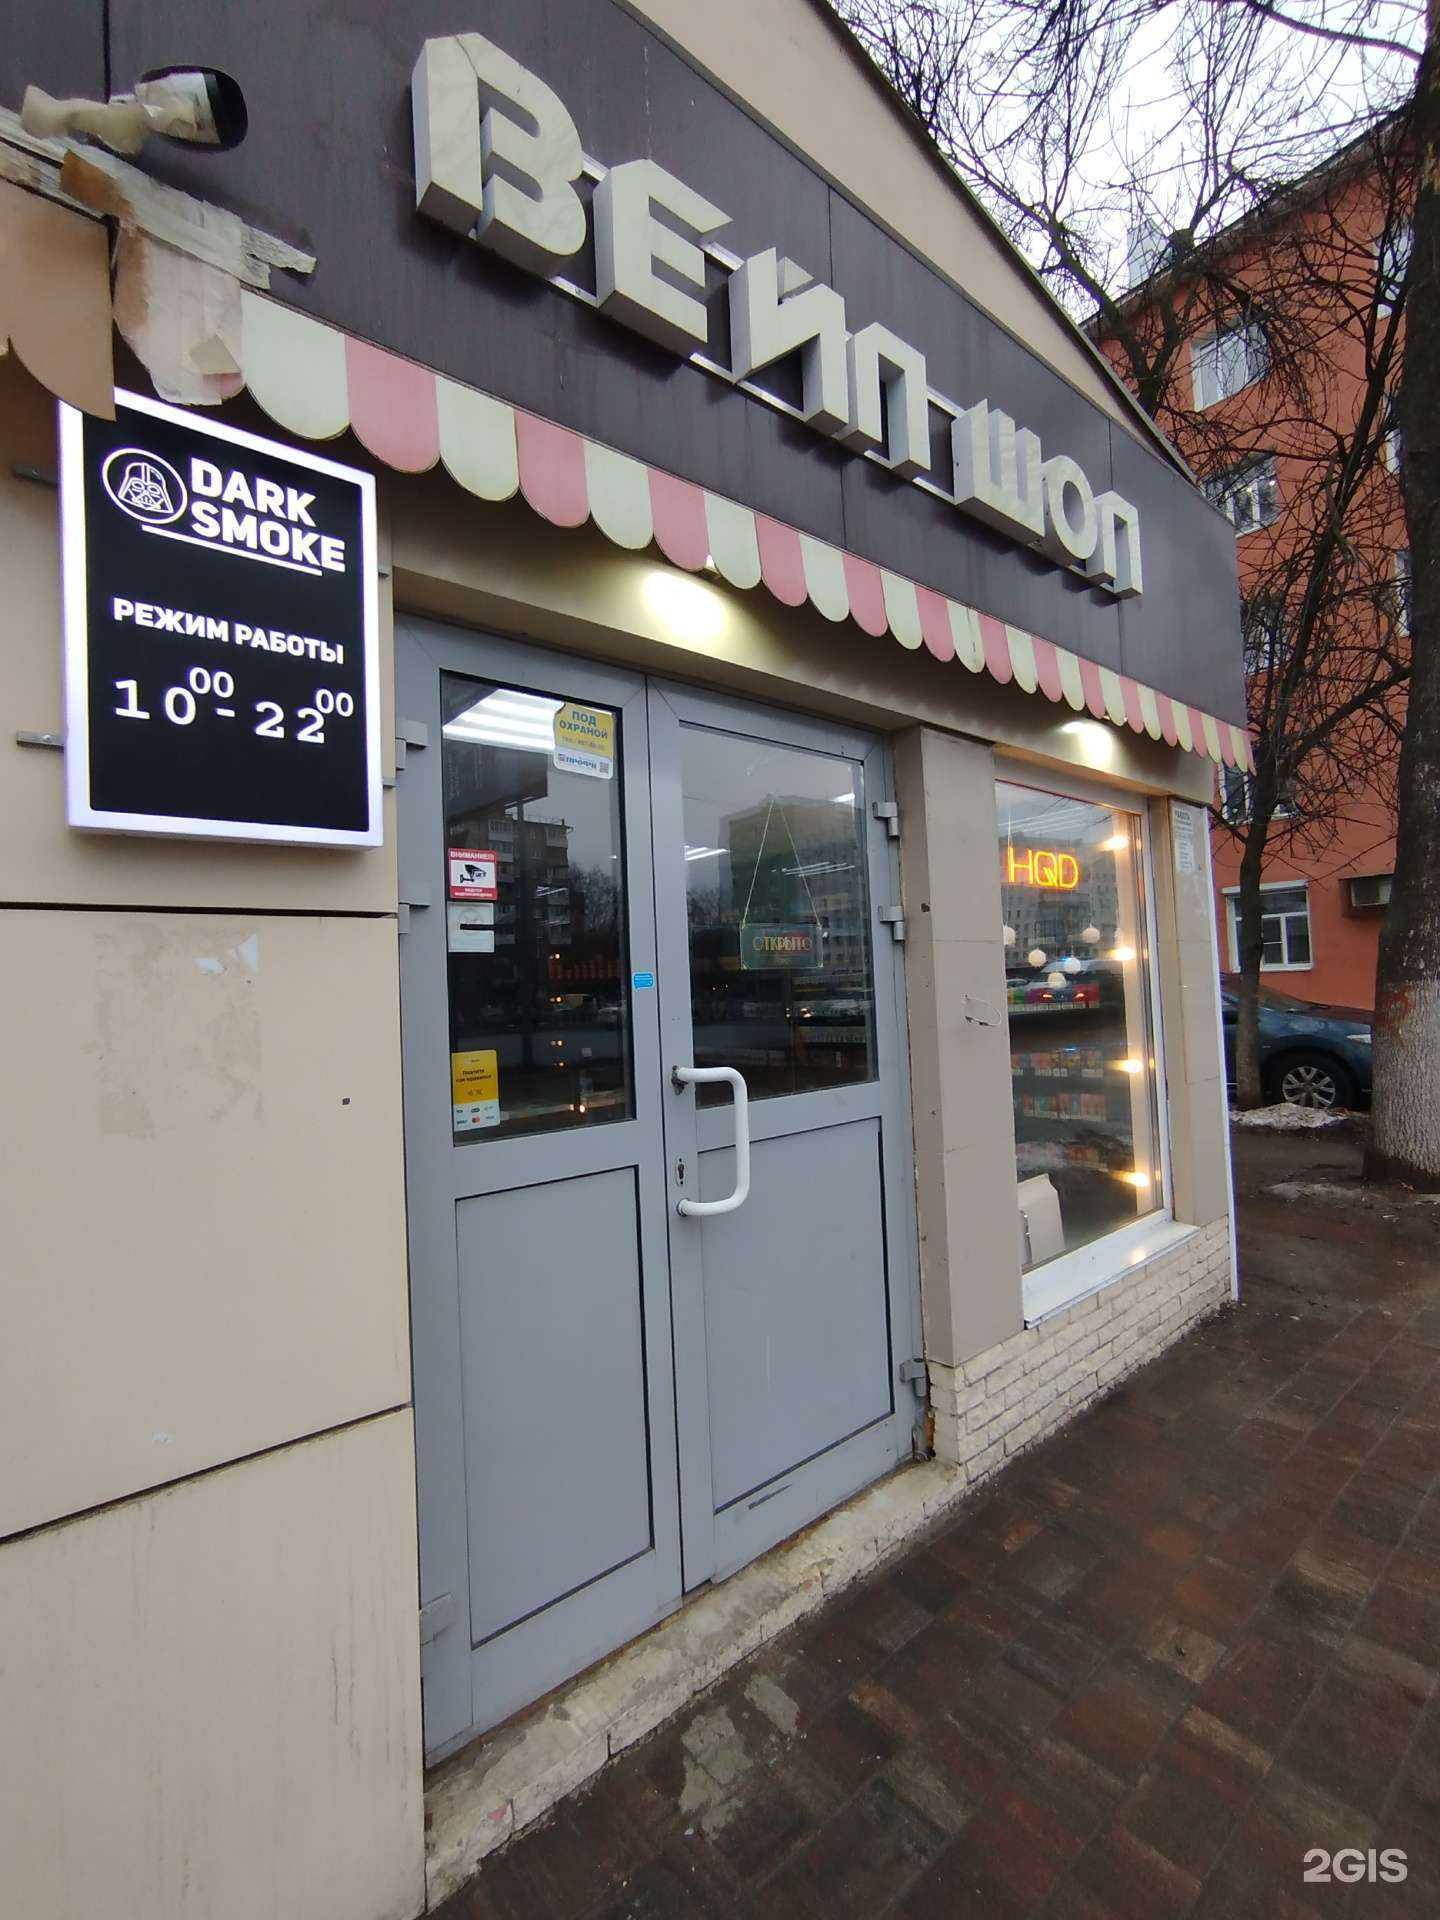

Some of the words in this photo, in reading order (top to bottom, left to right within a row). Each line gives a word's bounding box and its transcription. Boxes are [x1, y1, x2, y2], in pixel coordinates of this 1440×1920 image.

[412, 32, 932, 473] ВЕЙП
[951, 398, 1143, 597] ШОП
[190, 457, 316, 527] DARK
[191, 501, 346, 572] SMOKE
[113, 597, 230, 642] РЕЖИМ
[234, 622, 344, 665] РАБОТЫ
[560, 719, 608, 739] ОХРАНОЙ
[572, 710, 597, 727] ПОД
[1008, 847, 1079, 889] HQD
[752, 936, 812, 951] ОТКРЫТО
